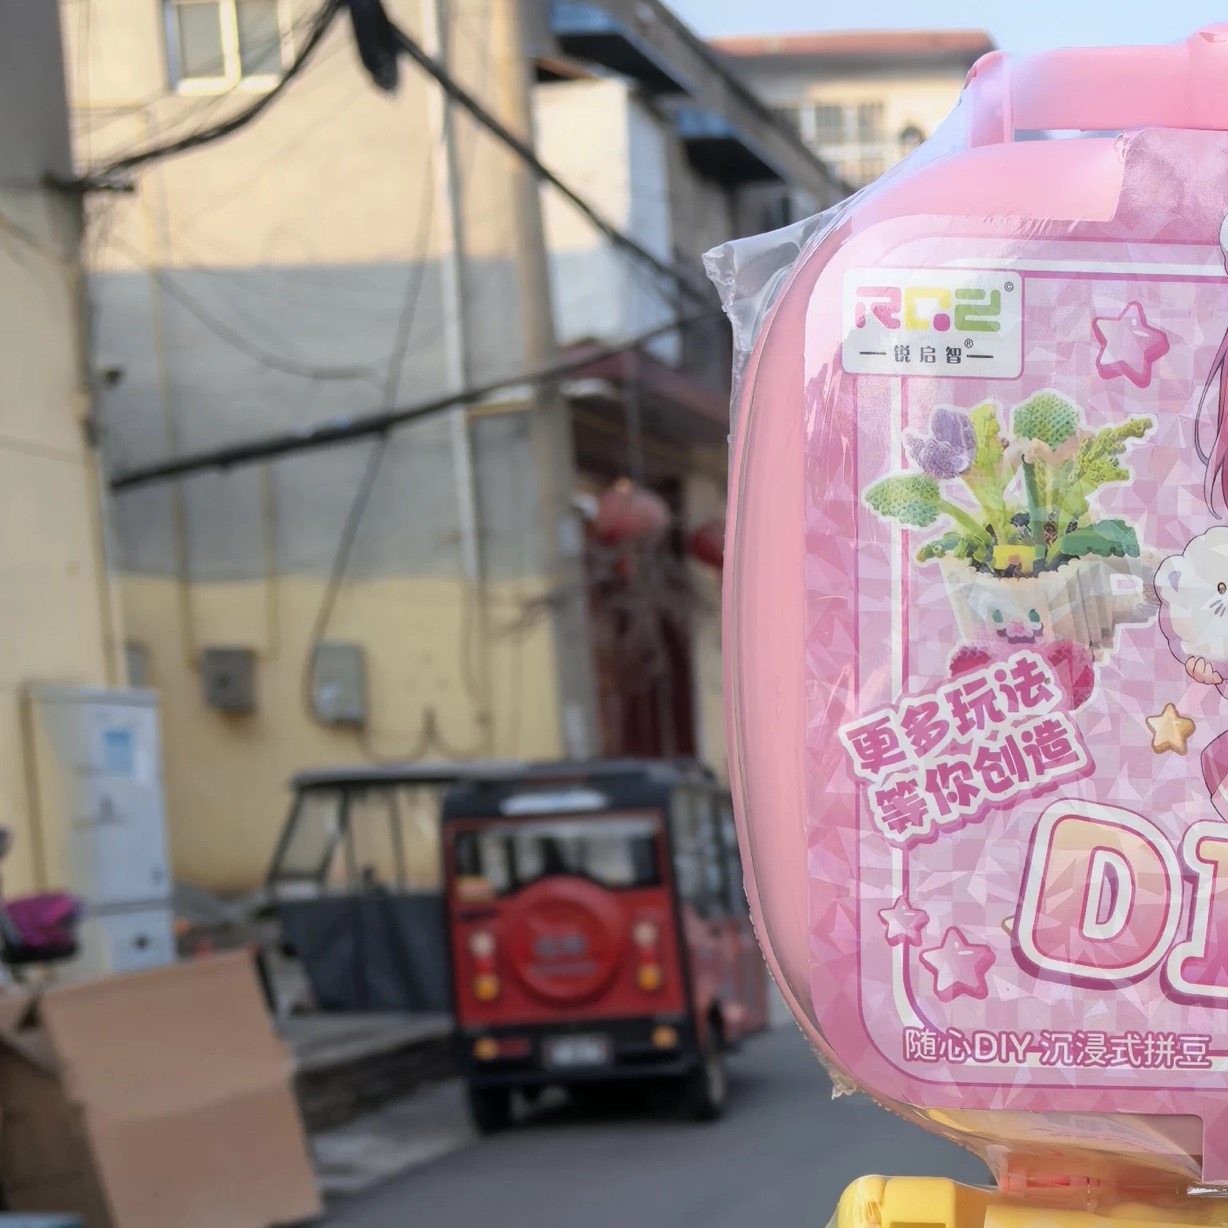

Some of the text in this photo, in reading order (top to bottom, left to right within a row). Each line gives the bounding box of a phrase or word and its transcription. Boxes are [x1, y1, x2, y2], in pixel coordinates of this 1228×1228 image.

[846, 656, 1055, 775] 更多玩法
[874, 718, 1081, 833] 等你创造
